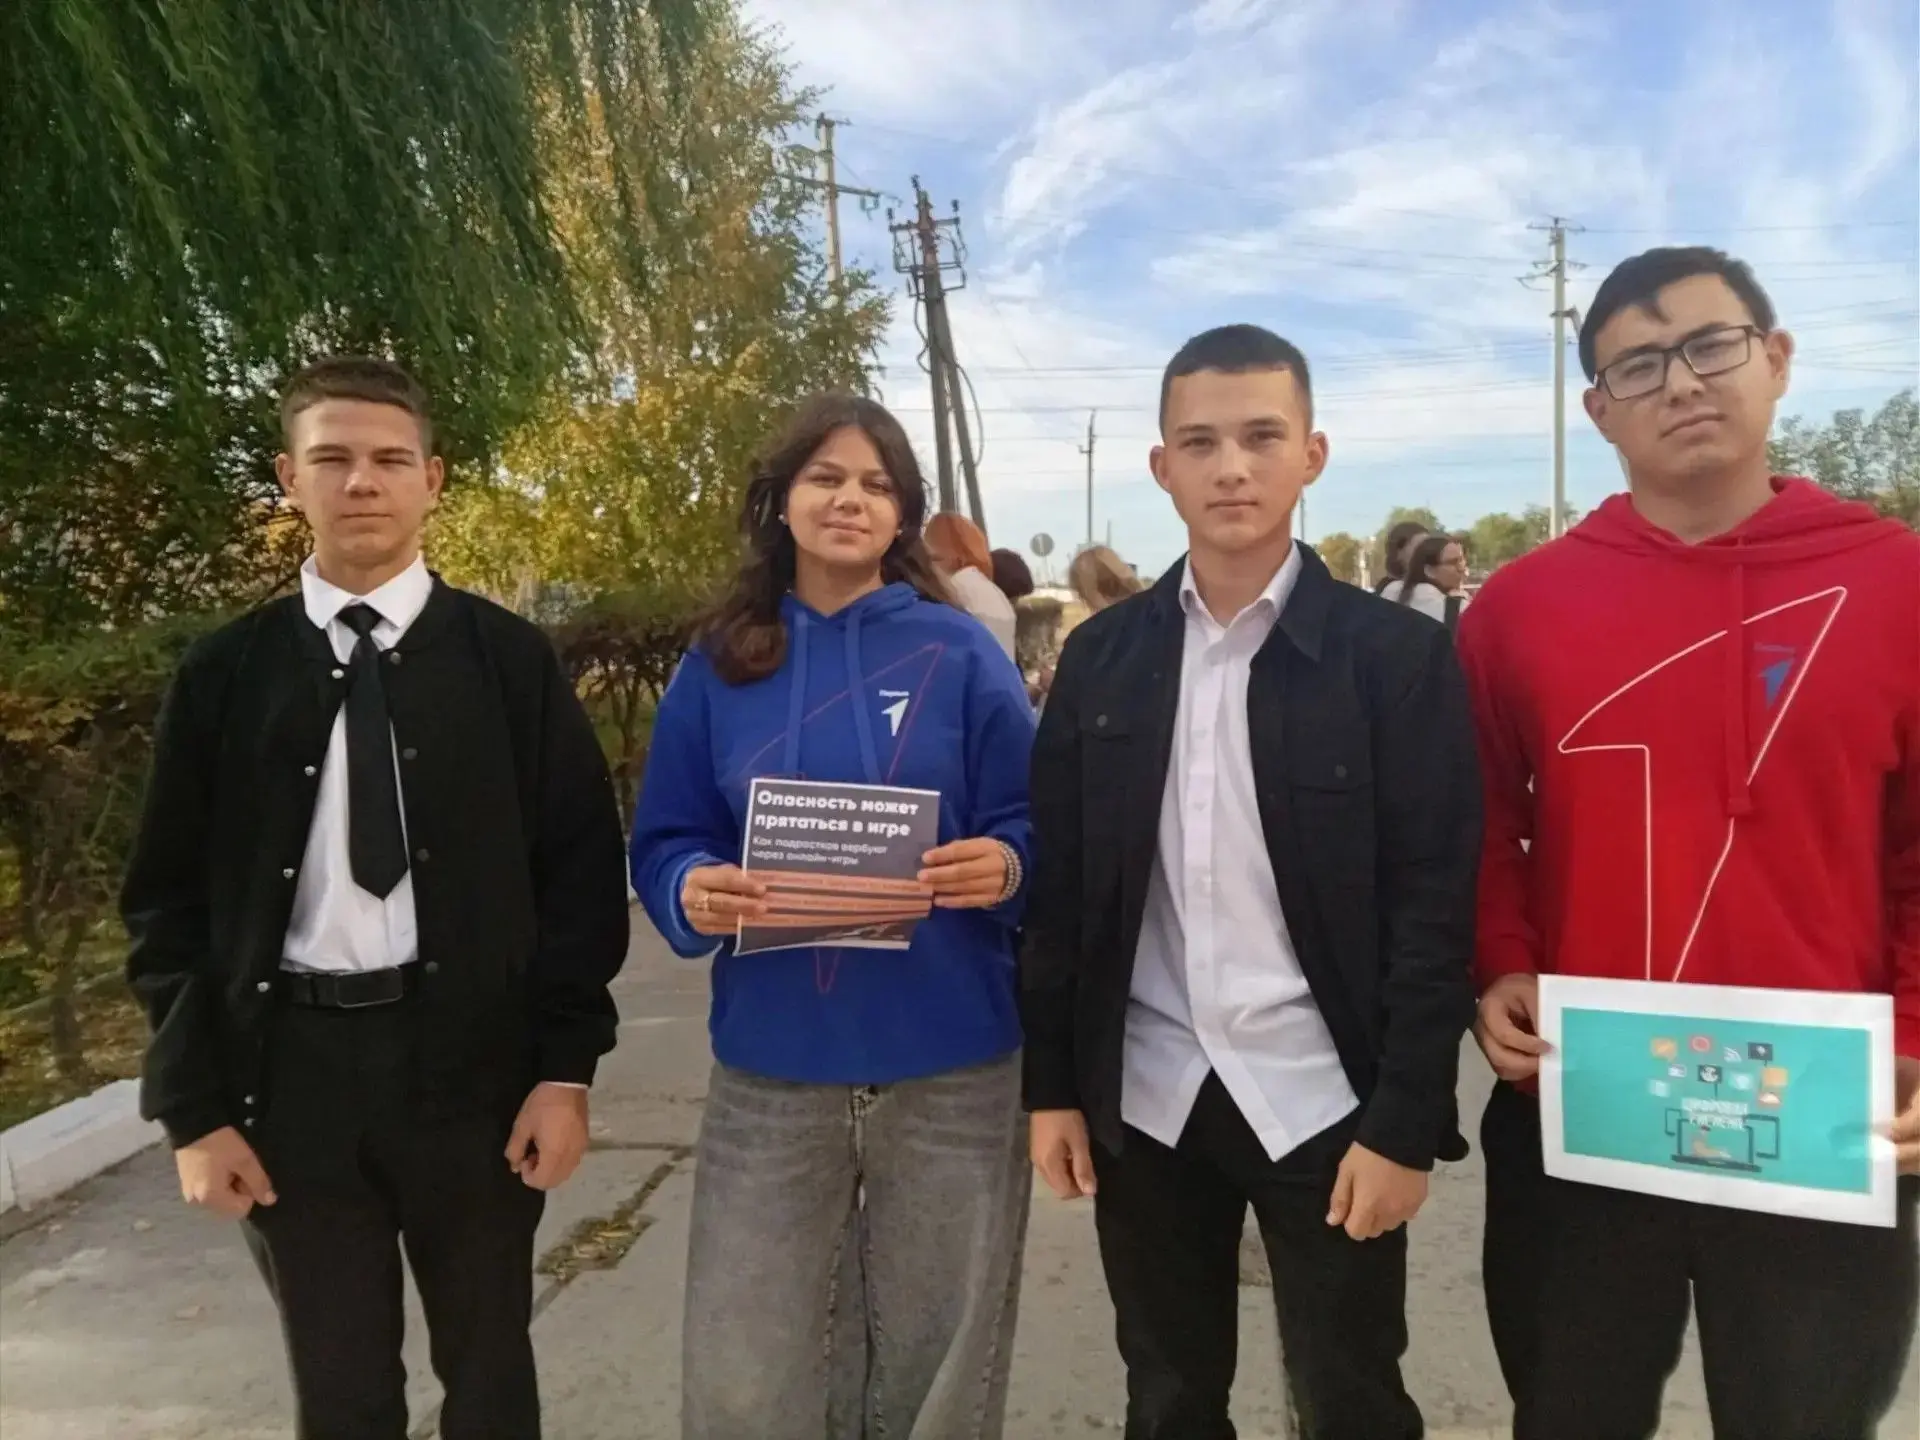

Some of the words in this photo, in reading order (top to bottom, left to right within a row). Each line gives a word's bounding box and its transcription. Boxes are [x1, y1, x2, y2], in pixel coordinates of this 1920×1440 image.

[757, 790, 857, 811] Опасность
[861, 800, 919, 815] может
[755, 814, 849, 830] прятаться
[852, 820, 863, 832] в
[867, 822, 911, 838] игре
[752, 836, 772, 846] Как
